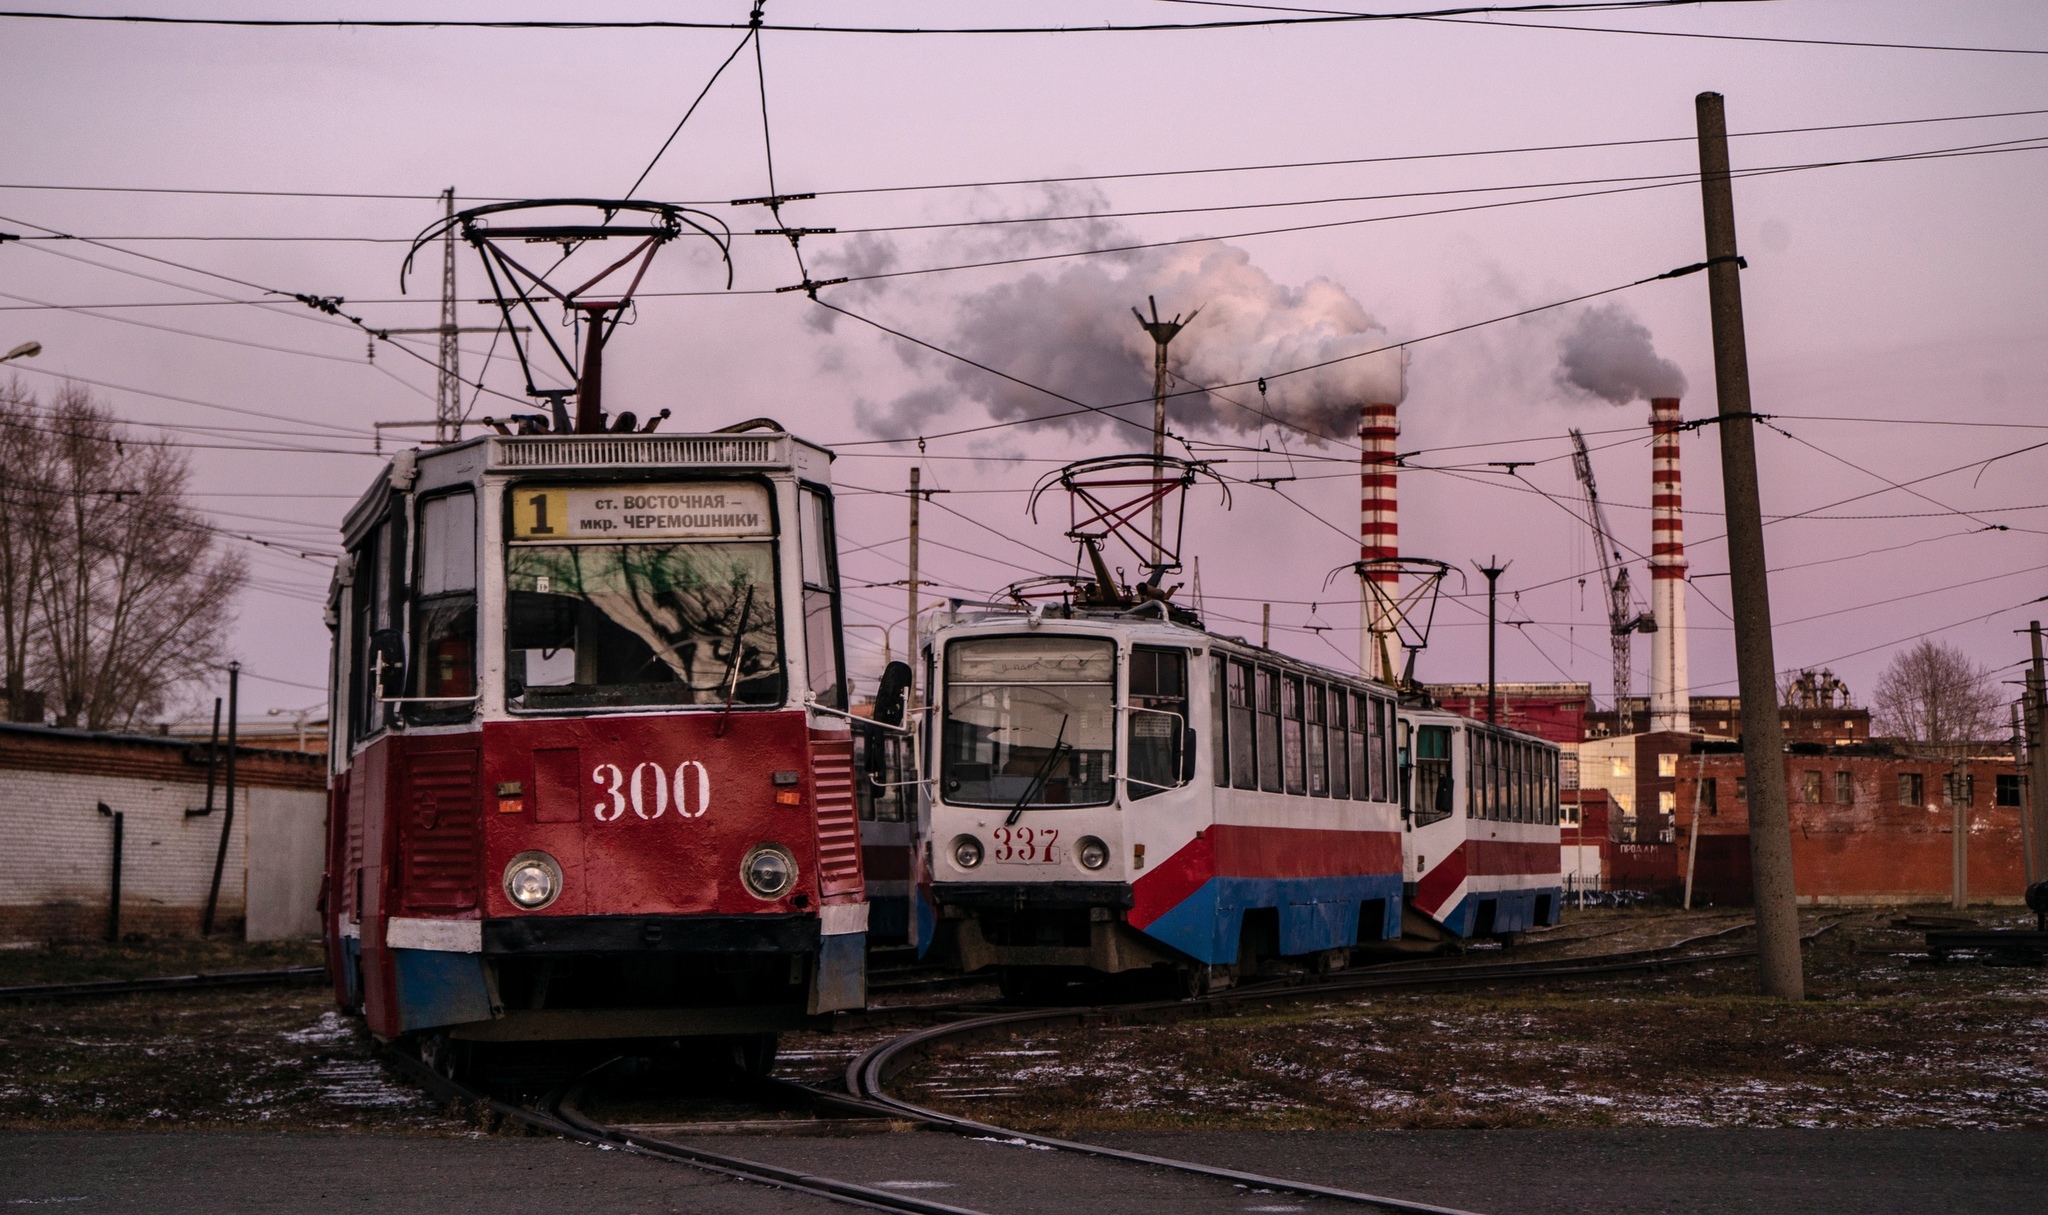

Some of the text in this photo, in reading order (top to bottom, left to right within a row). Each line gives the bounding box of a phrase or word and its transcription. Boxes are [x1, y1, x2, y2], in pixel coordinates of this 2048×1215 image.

[529, 493, 554, 534] 1
[595, 499, 618, 510] ст.
[623, 494, 725, 510] ВОСТОЧНАЯ
[580, 513, 758, 532] мкр. ЧЕРЕМОШНИКИ
[592, 760, 710, 822] 300
[993, 827, 1059, 862] 337
[1620, 844, 1659, 853] ПРОДАМ
